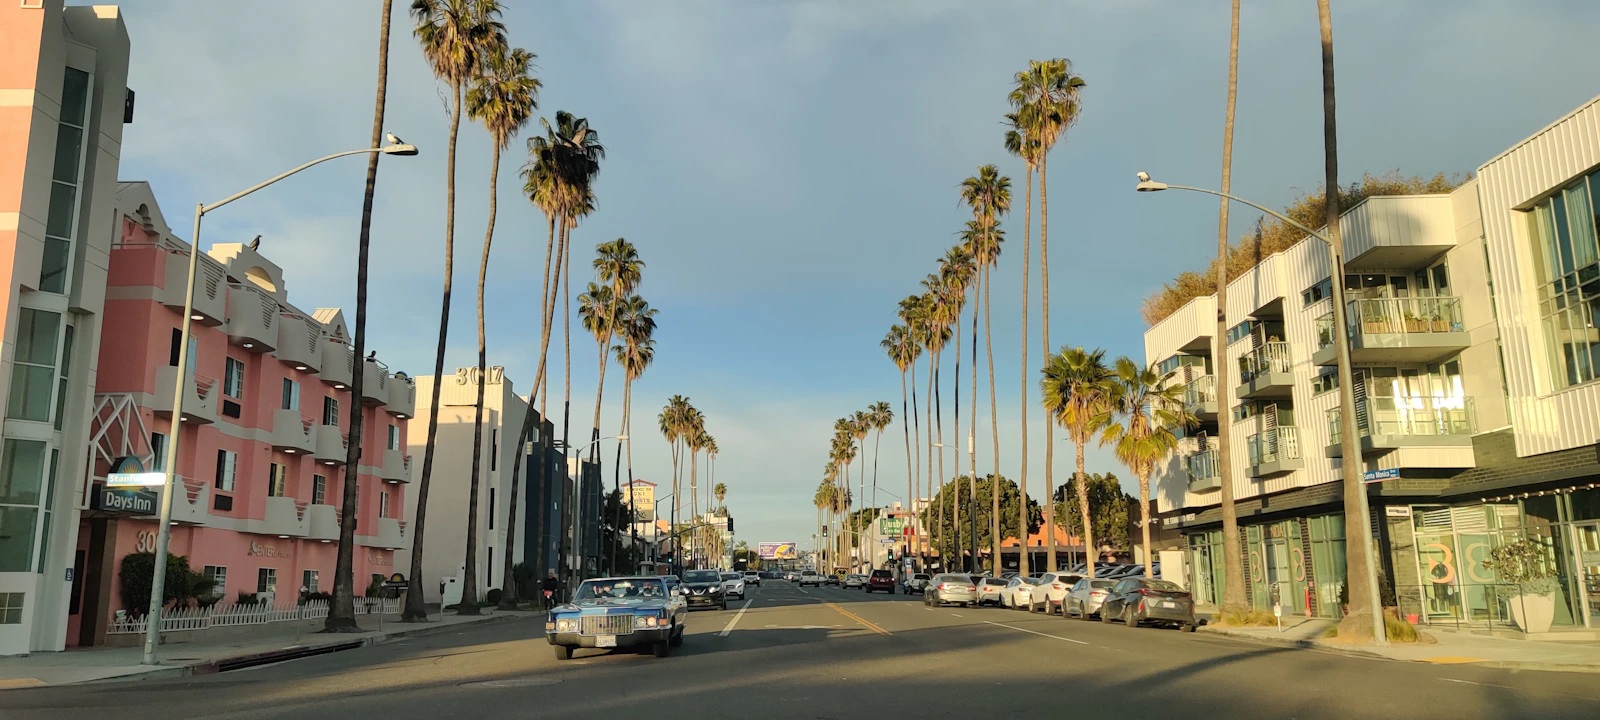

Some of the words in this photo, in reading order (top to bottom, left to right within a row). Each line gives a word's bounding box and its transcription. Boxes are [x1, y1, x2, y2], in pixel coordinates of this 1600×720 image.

[456, 366, 502, 385] 3017
[109, 474, 144, 483] Stanf
[106, 491, 133, 510] Days
[134, 495, 151, 511] Inn
